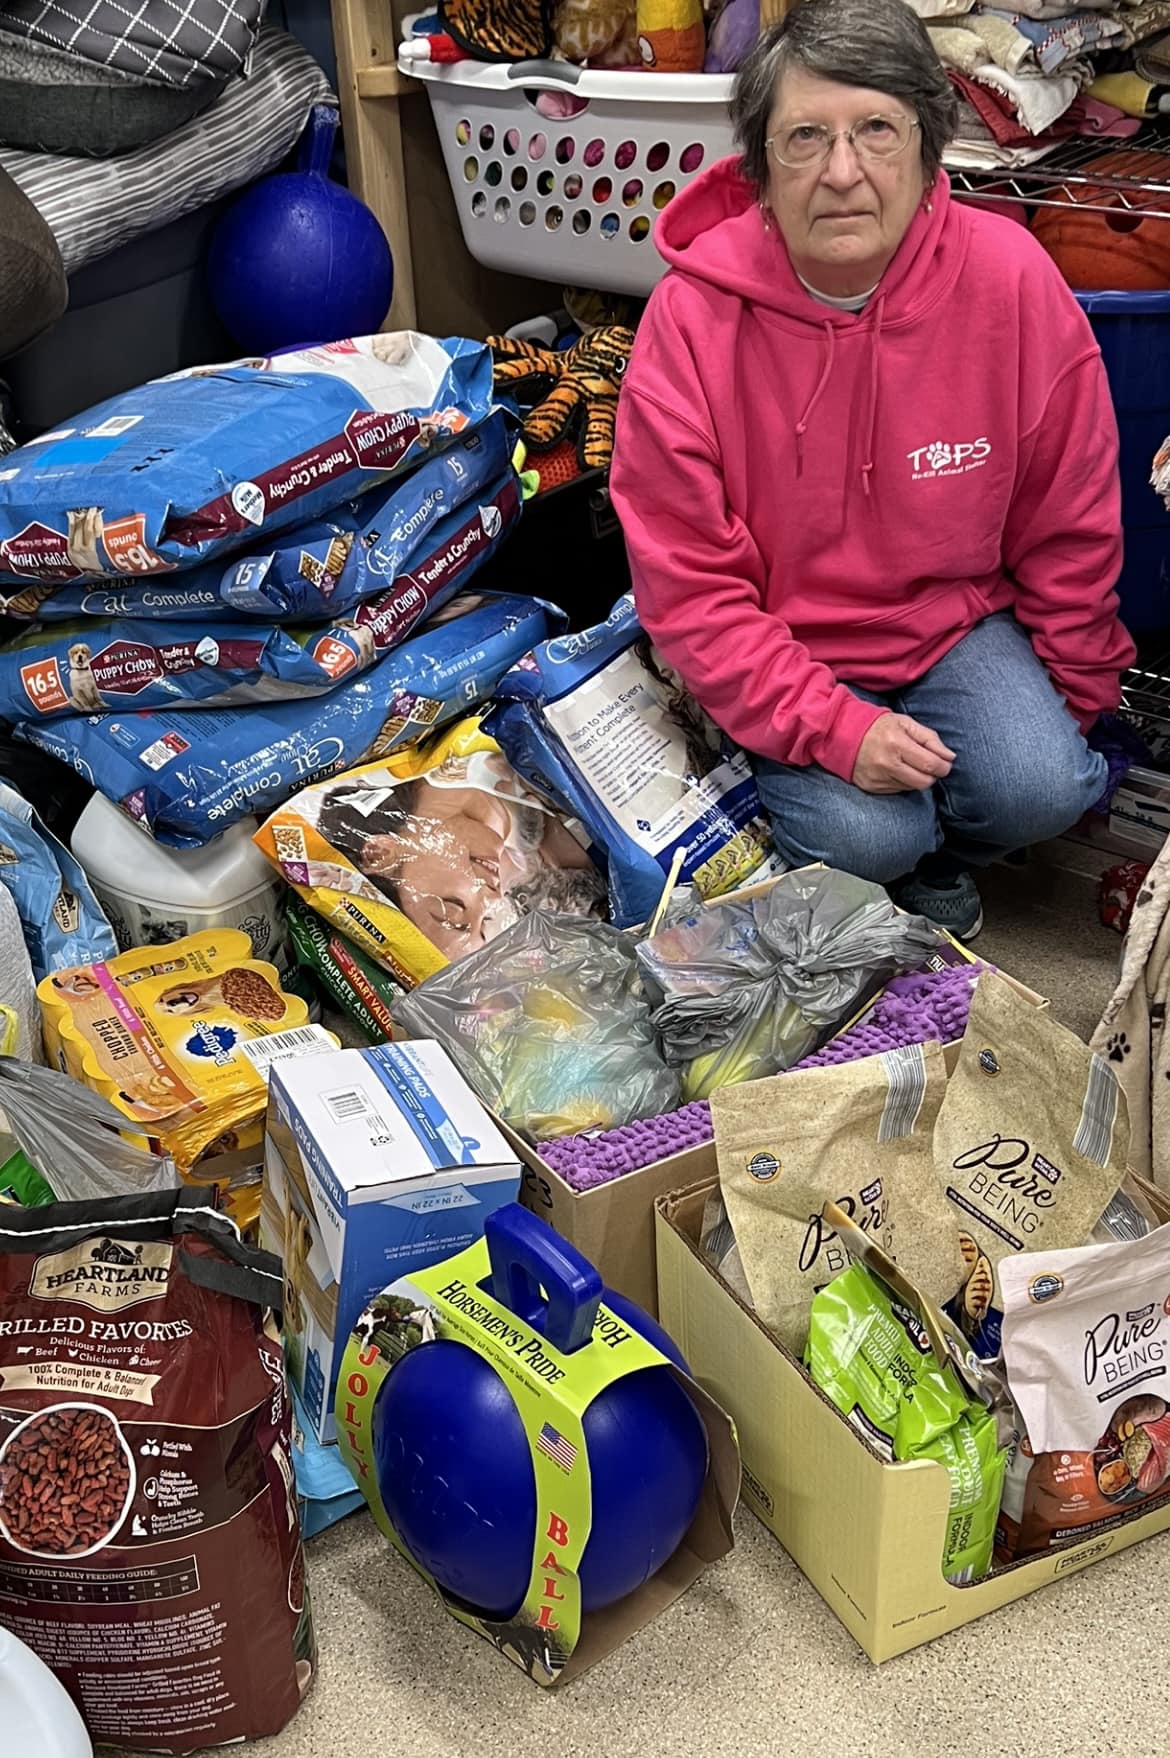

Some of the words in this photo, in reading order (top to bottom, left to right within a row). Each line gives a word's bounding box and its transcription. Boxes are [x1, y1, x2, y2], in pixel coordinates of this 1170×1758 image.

[356, 427, 385, 451] CHOW
[385, 412, 415, 434] PUPPY
[318, 449, 351, 475] Tender
[269, 470, 310, 499] Crunchy
[114, 544, 158, 572] 16.5
[418, 558, 449, 586] Tender
[450, 527, 482, 557] Crunchy
[235, 563, 253, 585] 15
[80, 590, 133, 616] Cat
[142, 590, 217, 607] Complete
[395, 586, 421, 620] CHOW
[26, 671, 58, 697] 16.5
[94, 667, 123, 682] PUPPY
[124, 659, 157, 675] CHOW
[597, 700, 620, 720] Make
[618, 682, 645, 704] Every
[596, 704, 637, 737] Complete
[291, 737, 344, 775] Cat
[207, 772, 281, 820] Complete
[303, 915, 328, 953] CHOW
[347, 904, 384, 944] PURINA
[318, 950, 353, 1002] OMPLETE
[353, 1001, 383, 1037] ADULT
[347, 965, 372, 1000] SMART
[370, 997, 393, 1032] VALUE
[92, 1018, 129, 1061] CHOPPED
[192, 1022, 237, 1068] Pedigree
[408, 1074, 431, 1099] PADS
[311, 1147, 344, 1208] TRAINING
[952, 1132, 1057, 1208] Pure
[422, 1199, 434, 1208] 22
[968, 1172, 1040, 1234] BEING
[46, 1266, 169, 1289] HEARTLAND
[75, 1283, 142, 1297] FARMS
[50, 1336, 94, 1352] Delicious
[97, 1344, 132, 1354] Flavors
[88, 1319, 193, 1341] FAVORTES
[436, 1280, 524, 1348] HORSEMEN'S
[513, 1338, 566, 1385] PRIDE
[35, 1347, 58, 1356] Beef
[79, 1352, 120, 1366] Chicken
[1084, 1313, 1162, 1386] Pure
[1103, 1342, 1164, 1383] BEING
[28, 1365, 52, 1375] 100%
[55, 1364, 100, 1379] Complete
[104, 1370, 111, 1380] &
[36, 1374, 78, 1388] Nutrition
[81, 1378, 95, 1389] for
[99, 1382, 119, 1394] Adult
[345, 1343, 381, 1480] JOLLY
[959, 1427, 983, 1501] PREMIUM
[28, 1568, 58, 1578] ADULT
[59, 1570, 85, 1580] DAILY
[534, 1511, 570, 1632] BALL
